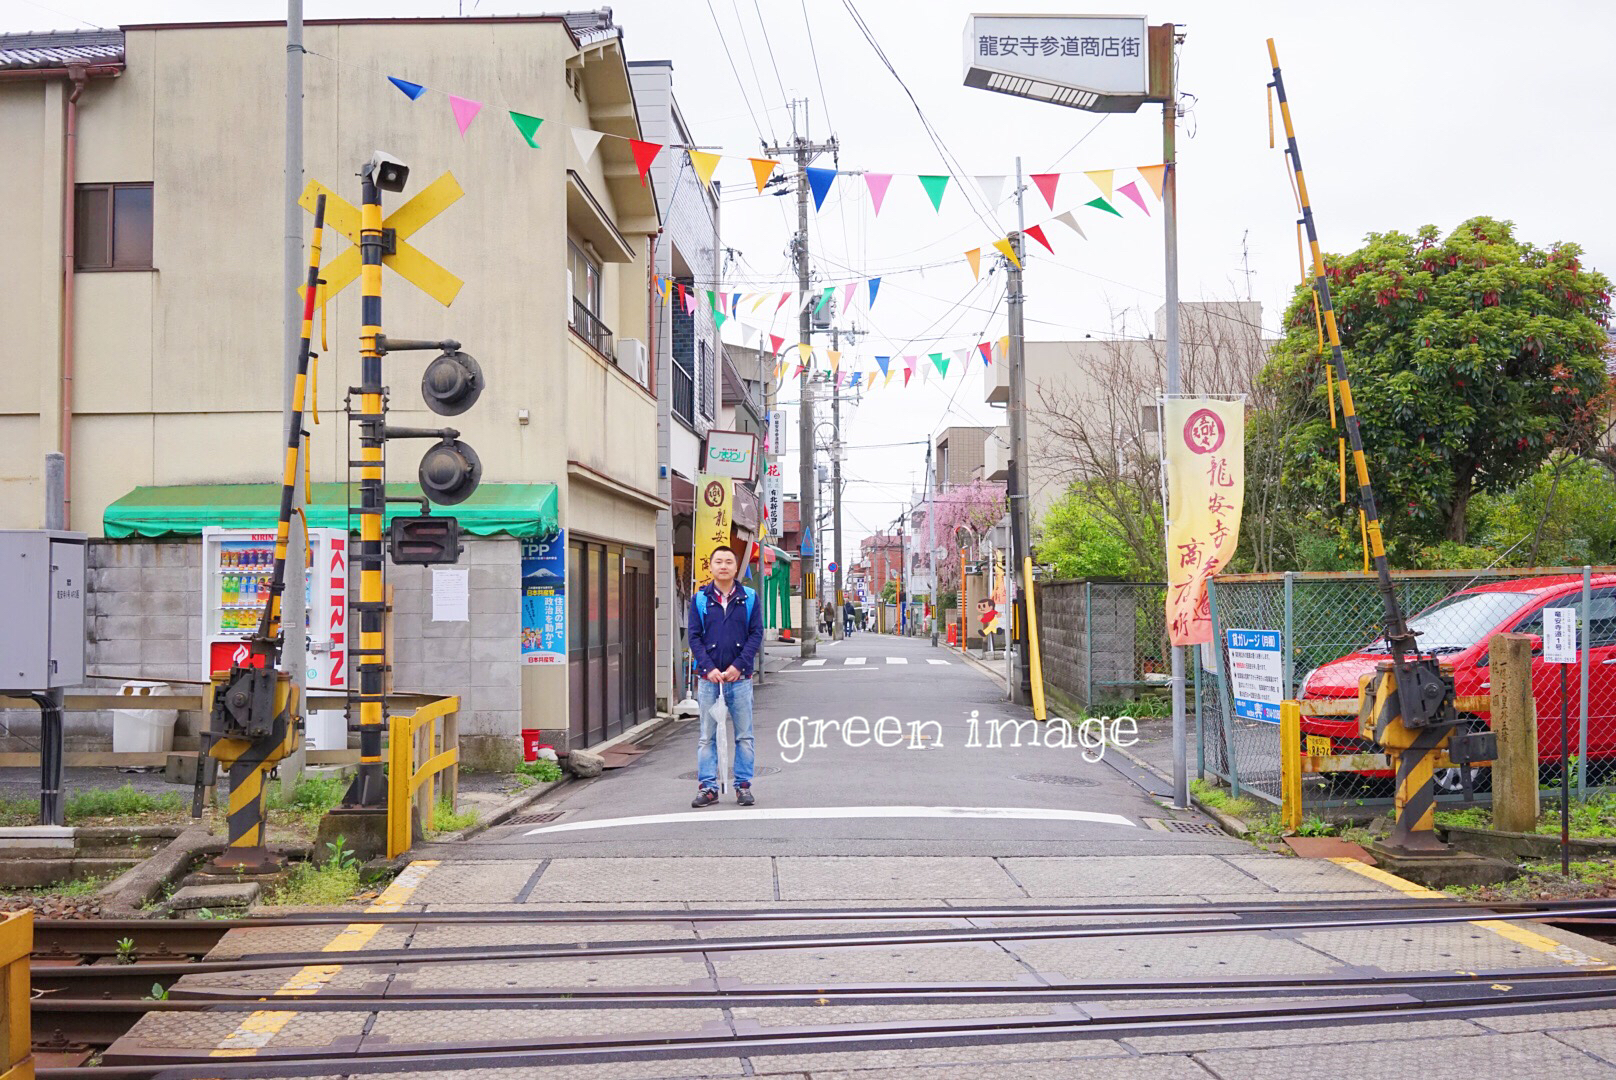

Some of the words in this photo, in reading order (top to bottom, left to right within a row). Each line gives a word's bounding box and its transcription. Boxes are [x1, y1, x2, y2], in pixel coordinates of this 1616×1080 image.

[978, 35, 1141, 58] 龍安寺参道商店街
[709, 446, 747, 463] ひまわり
[766, 464, 781, 477] 花
[521, 544, 550, 557] TPP
[527, 589, 555, 597] 日本共産党
[329, 538, 345, 686] KIRIN
[554, 597, 564, 639] 住民の声で
[544, 597, 554, 650] 政治を動かす
[1232, 633, 1260, 647] 貸ガレージ
[527, 656, 555, 664] 日本共産党
